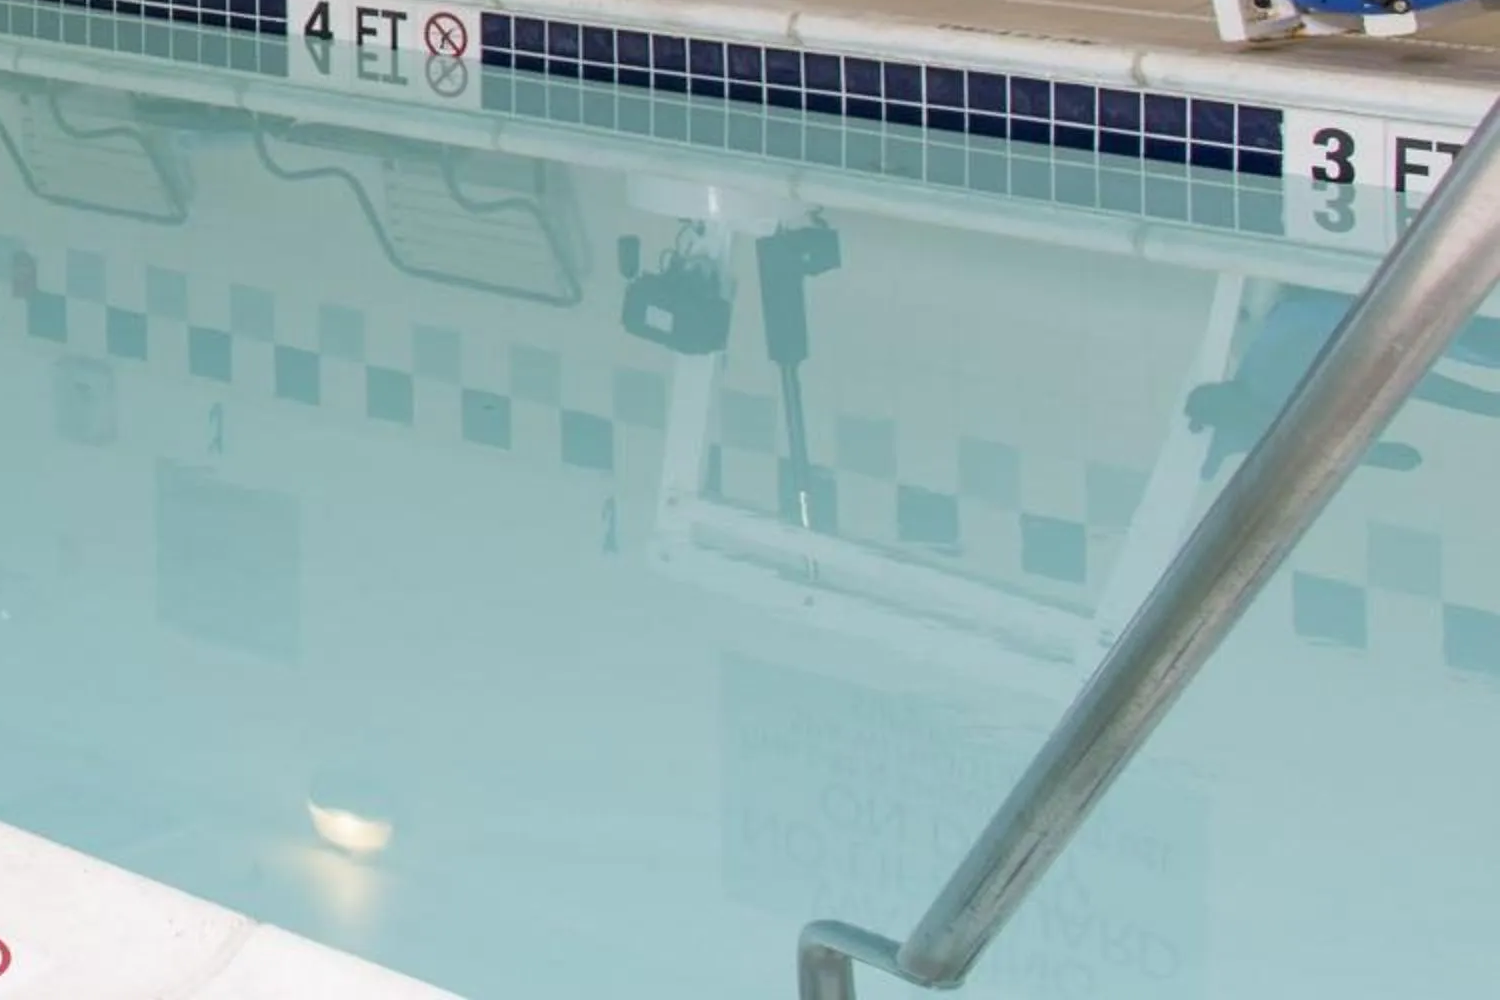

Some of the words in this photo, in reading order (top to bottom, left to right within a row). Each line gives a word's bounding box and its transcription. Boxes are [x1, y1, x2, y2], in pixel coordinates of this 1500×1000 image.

[304, 1, 333, 40] 4
[356, 6, 407, 50] FT
[1311, 128, 1356, 184] 3
